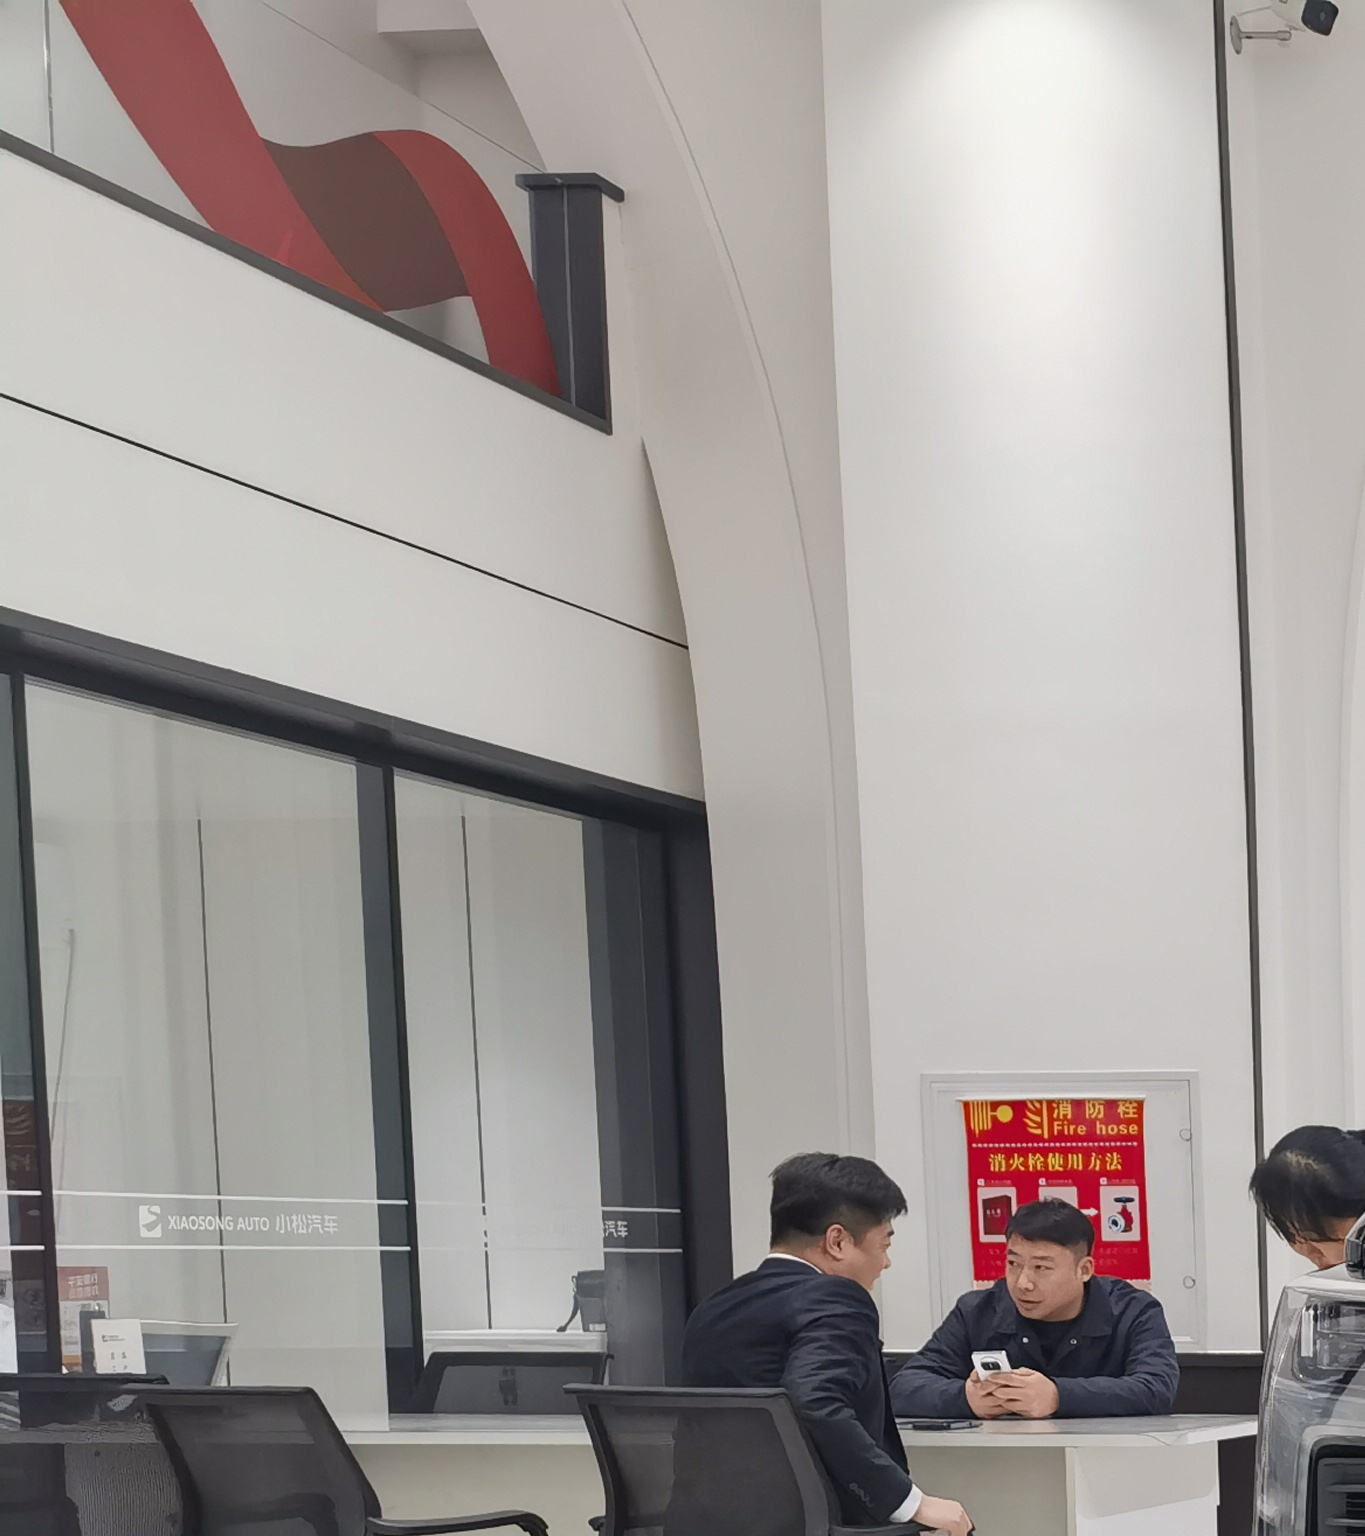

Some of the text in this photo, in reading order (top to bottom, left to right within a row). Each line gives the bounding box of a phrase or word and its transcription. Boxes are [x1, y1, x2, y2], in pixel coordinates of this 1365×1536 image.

[1053, 1120, 1139, 1136] Fire hose
[988, 1152, 1122, 1172] 消火栓使用方法
[168, 1213, 339, 1234] XIAOSONG AUTO 小松汽车
[602, 1220, 629, 1238] 汽车
